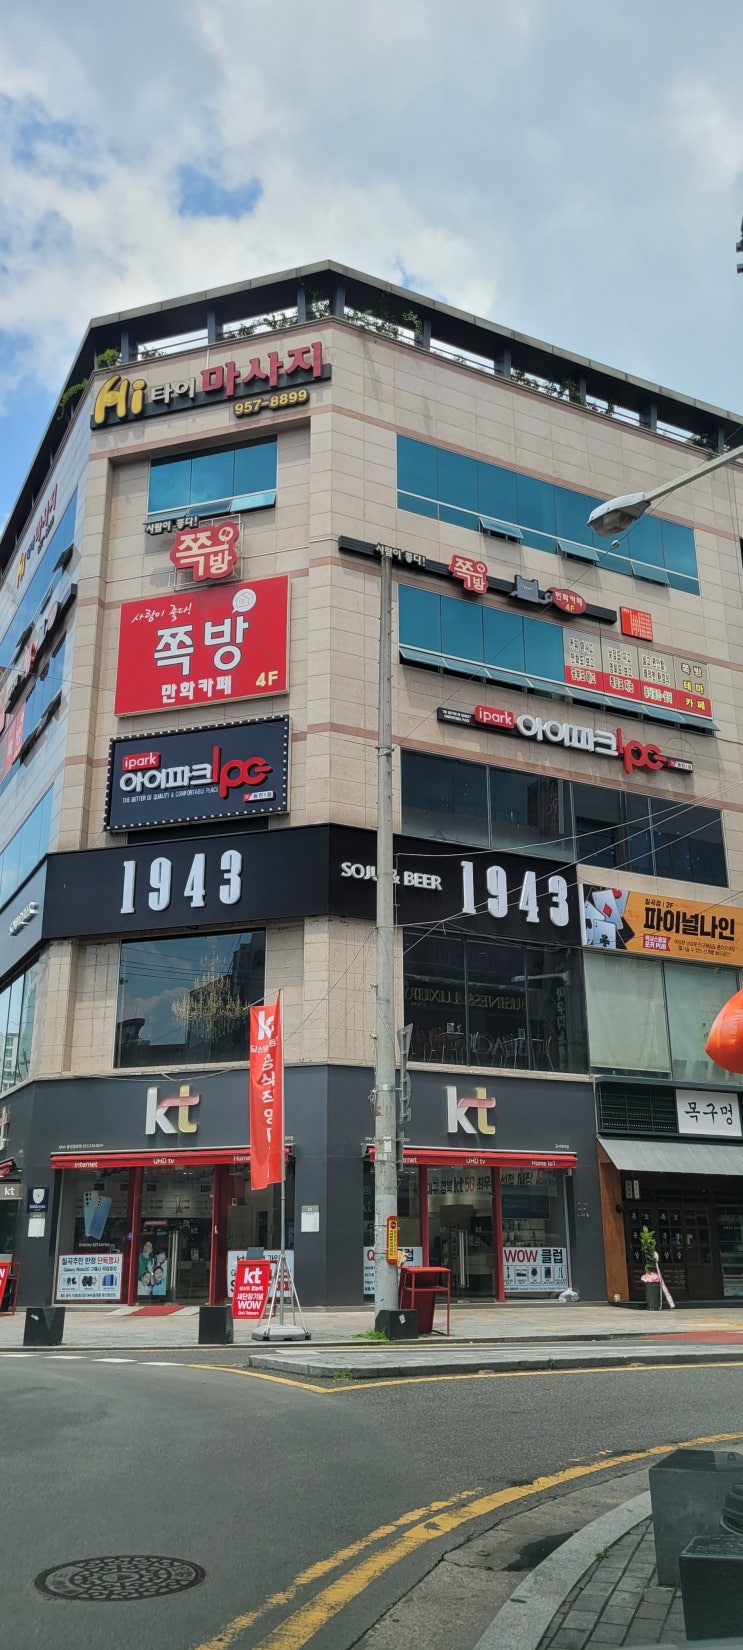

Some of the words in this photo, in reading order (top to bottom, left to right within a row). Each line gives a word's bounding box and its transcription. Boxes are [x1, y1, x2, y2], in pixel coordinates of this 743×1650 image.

[94, 375, 147, 424] Hi
[151, 376, 197, 404] 타이
[201, 342, 322, 397] 마사지
[234, 389, 308, 416] 957-8899
[146, 523, 172, 534] 사람이
[176, 516, 199, 530] 좋다!
[176, 530, 233, 576] 쪽방
[375, 542, 402, 560] 사람이
[405, 551, 427, 567] 좋다!
[454, 558, 486, 591] 쪽방
[169, 603, 193, 622] 좋다!
[565, 604, 575, 612] 4F
[255, 671, 278, 687] 4F
[682, 680, 704, 695] 테마
[161, 675, 232, 704] 만화카페
[685, 697, 706, 711] 카페
[479, 708, 512, 726] ipark
[517, 714, 618, 756] 아이파크
[124, 752, 157, 770] ipark
[120, 764, 213, 793] 아이파크
[120, 849, 242, 914] 1943
[403, 870, 443, 891] BEER
[461, 860, 570, 927] 1943
[643, 906, 735, 942] 파이널나인
[645, 941, 655, 949] 포커
[145, 1085, 200, 1135] kt
[446, 1085, 496, 1135] kt
[684, 1101, 733, 1126] 목구멍
[169, 1157, 175, 1165] tv
[233, 1154, 250, 1162] Home
[4, 1186, 15, 1196] kt
[464, 1175, 475, 1193] 5G
[61, 1256, 84, 1265] 칠곡주민
[84, 1257, 96, 1265] 한정
[504, 1250, 538, 1263] WOW
[541, 1249, 564, 1264] 클럽
[243, 1267, 262, 1284] kt
[237, 1300, 262, 1310] WOW
